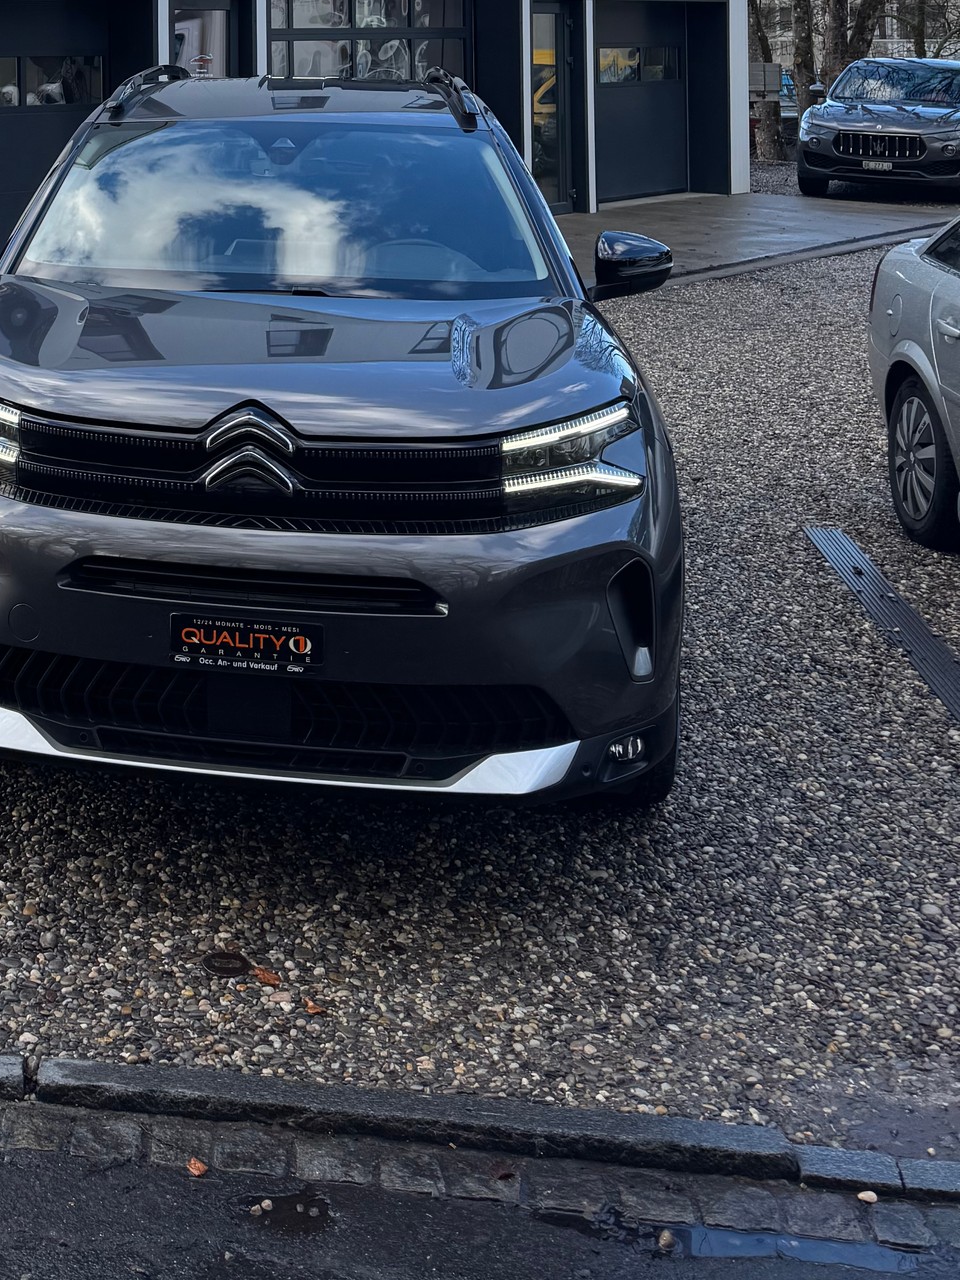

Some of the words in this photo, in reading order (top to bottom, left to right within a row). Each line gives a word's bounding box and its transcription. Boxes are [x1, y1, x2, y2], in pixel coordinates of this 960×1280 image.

[215, 620, 244, 628] MONATE
[181, 627, 286, 651] QUALITY
[198, 657, 215, 665] Occ.
[232, 660, 247, 668] und
[248, 661, 278, 671] Verkauf
